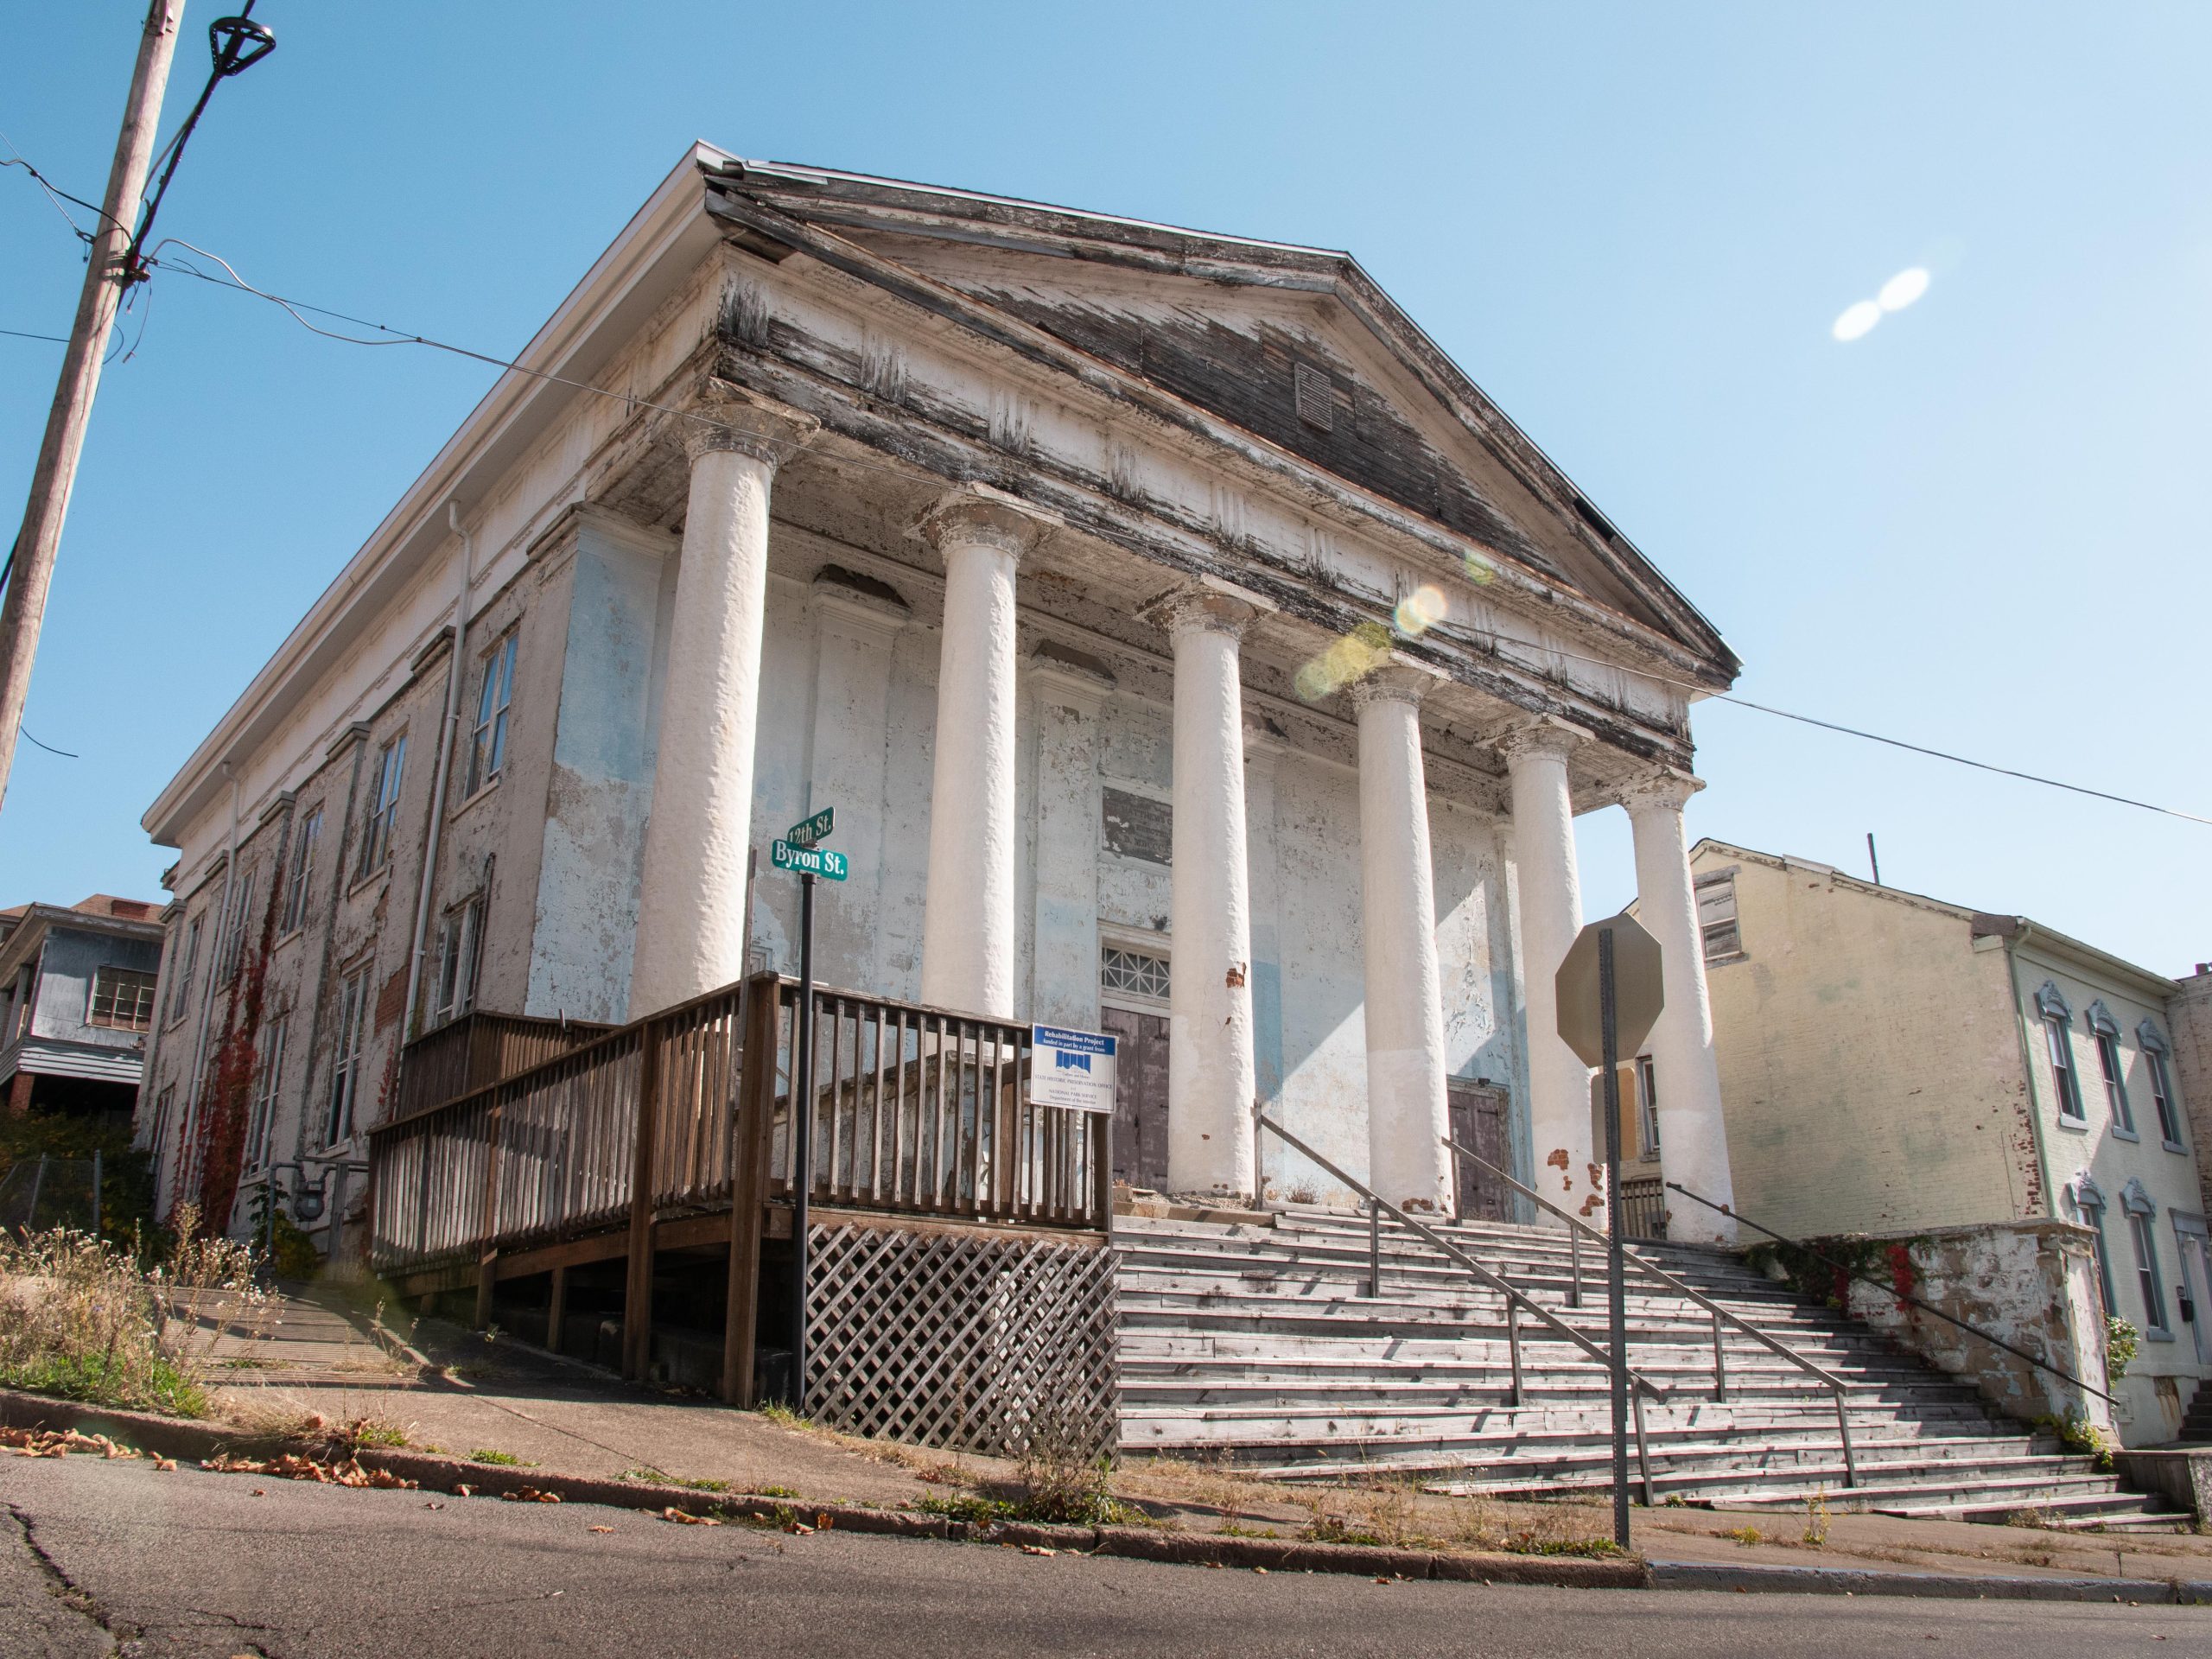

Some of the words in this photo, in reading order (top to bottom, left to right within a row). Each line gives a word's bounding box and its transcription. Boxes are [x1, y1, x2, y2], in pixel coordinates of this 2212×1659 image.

[789, 823, 812, 844] 12th
[816, 815, 831, 836] St.
[776, 841, 820, 869] Byron
[825, 852, 844, 874] St.
[1045, 1031, 1084, 1043] Rehabilitation
[1084, 1037, 1104, 1046] Project
[1067, 1079, 1096, 1088] PRESERVATION
